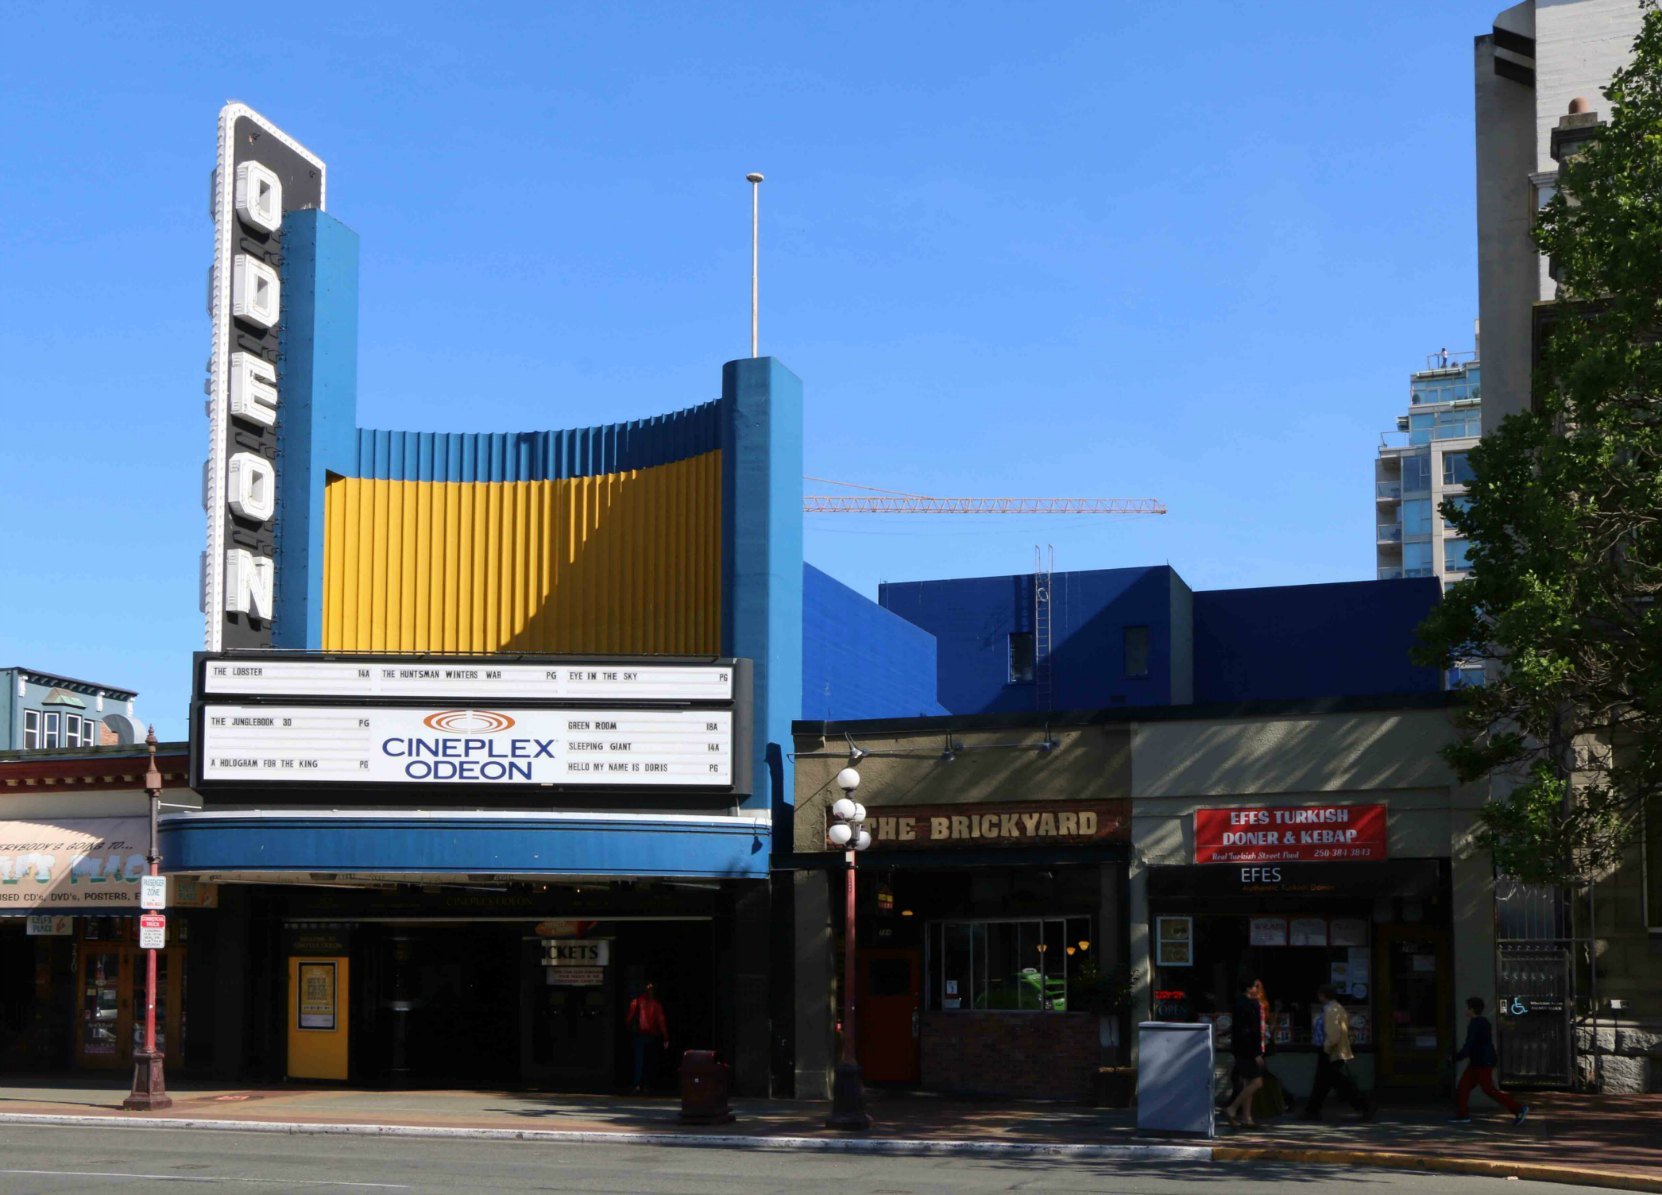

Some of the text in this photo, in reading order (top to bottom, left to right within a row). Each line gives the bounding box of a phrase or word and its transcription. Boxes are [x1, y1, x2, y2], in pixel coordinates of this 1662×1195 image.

[226, 160, 282, 621] ODEON
[214, 667, 263, 676] THE LOBSTER
[358, 670, 370, 678] 14A
[382, 670, 501, 680] THE HUNTSMAN WINTERS WAR
[546, 672, 557, 680] PG
[570, 672, 637, 681] EYE IN THE SKY
[719, 673, 728, 682] PG
[211, 717, 226, 726] THE
[232, 717, 274, 726] JUNGLEBOOK
[568, 721, 617, 730] GREEN ROOM
[706, 723, 718, 731] 18A
[382, 737, 555, 758] CINEPLEX
[568, 742, 631, 751] SLEEPING GIANT
[708, 743, 719, 752] 14A
[220, 759, 258, 768] HOLOGRAM
[264, 759, 276, 768] FOR
[281, 759, 294, 768] THE
[299, 760, 318, 768] KING
[360, 761, 368, 769] PG
[568, 763, 668, 772] HELLO MY NAME IS DORIS
[709, 764, 718, 772] PG
[405, 760, 532, 780] ODEON
[1230, 809, 1348, 825] EFES TURKISH
[863, 811, 1098, 840] THE BRICKYARD
[1222, 829, 1357, 845] DONER & KEBAP
[66, 842, 105, 850] GOING
[1229, 852, 1256, 860] Turkish
[1258, 851, 1280, 859] Street
[1241, 868, 1282, 882] EFES
